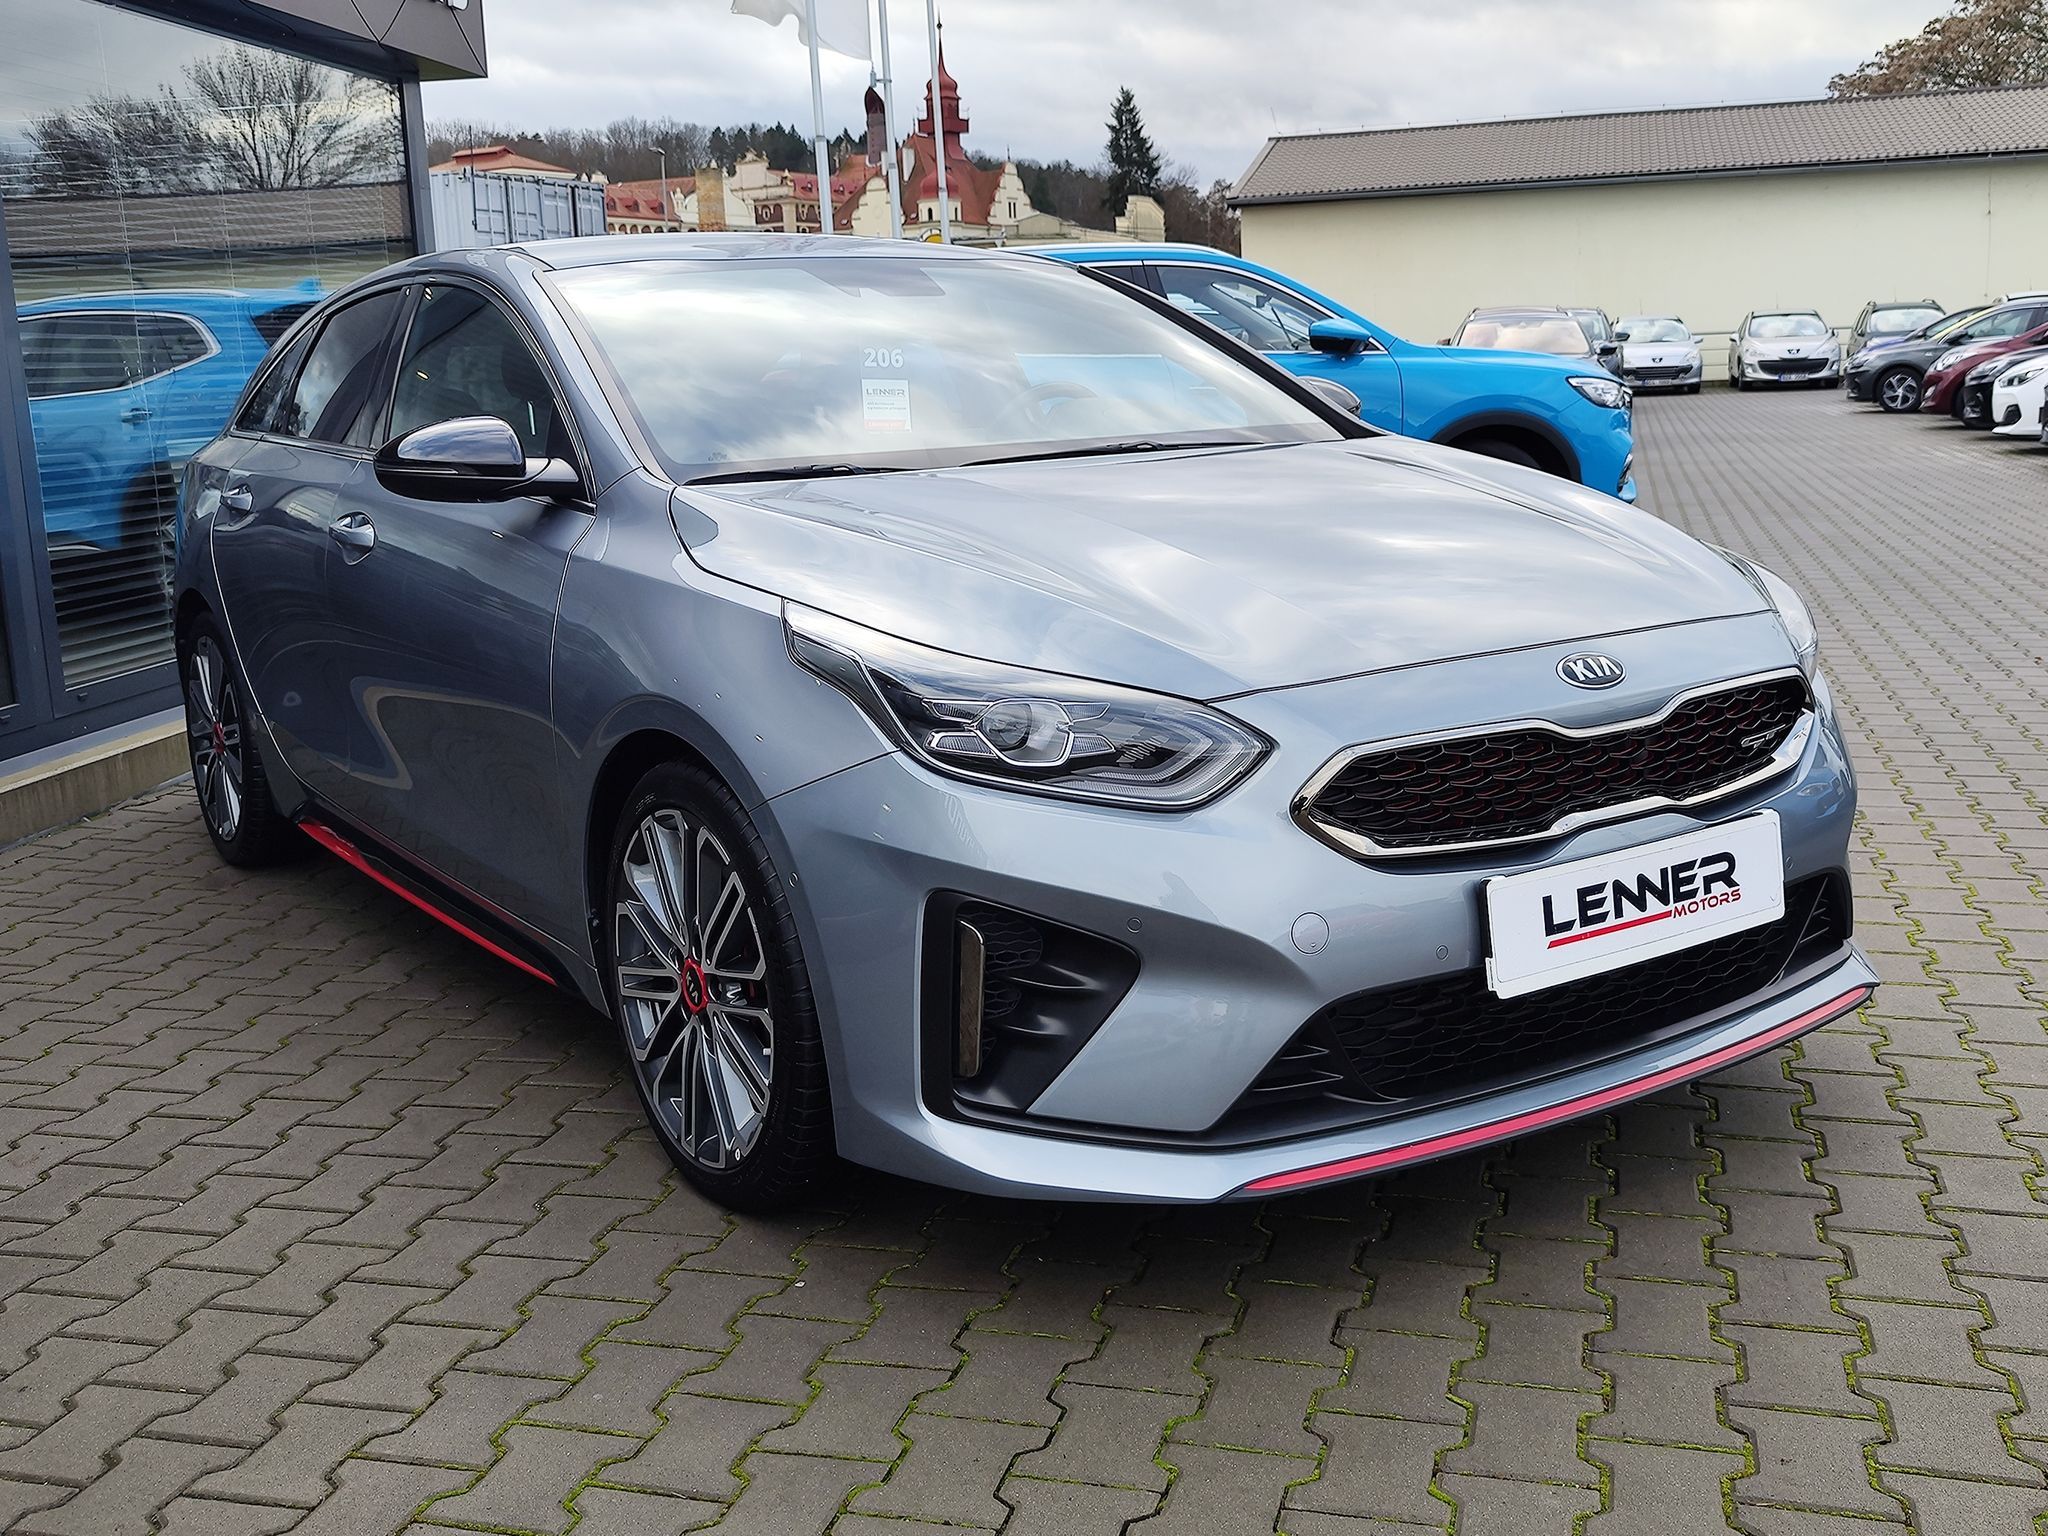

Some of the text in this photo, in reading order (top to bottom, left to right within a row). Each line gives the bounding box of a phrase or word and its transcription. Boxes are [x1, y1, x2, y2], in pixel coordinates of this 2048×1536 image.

[863, 347, 904, 368] 206
[1567, 656, 1620, 682] KIA
[1542, 851, 1740, 938] LENNER
[1671, 888, 1742, 919] MOTORS
